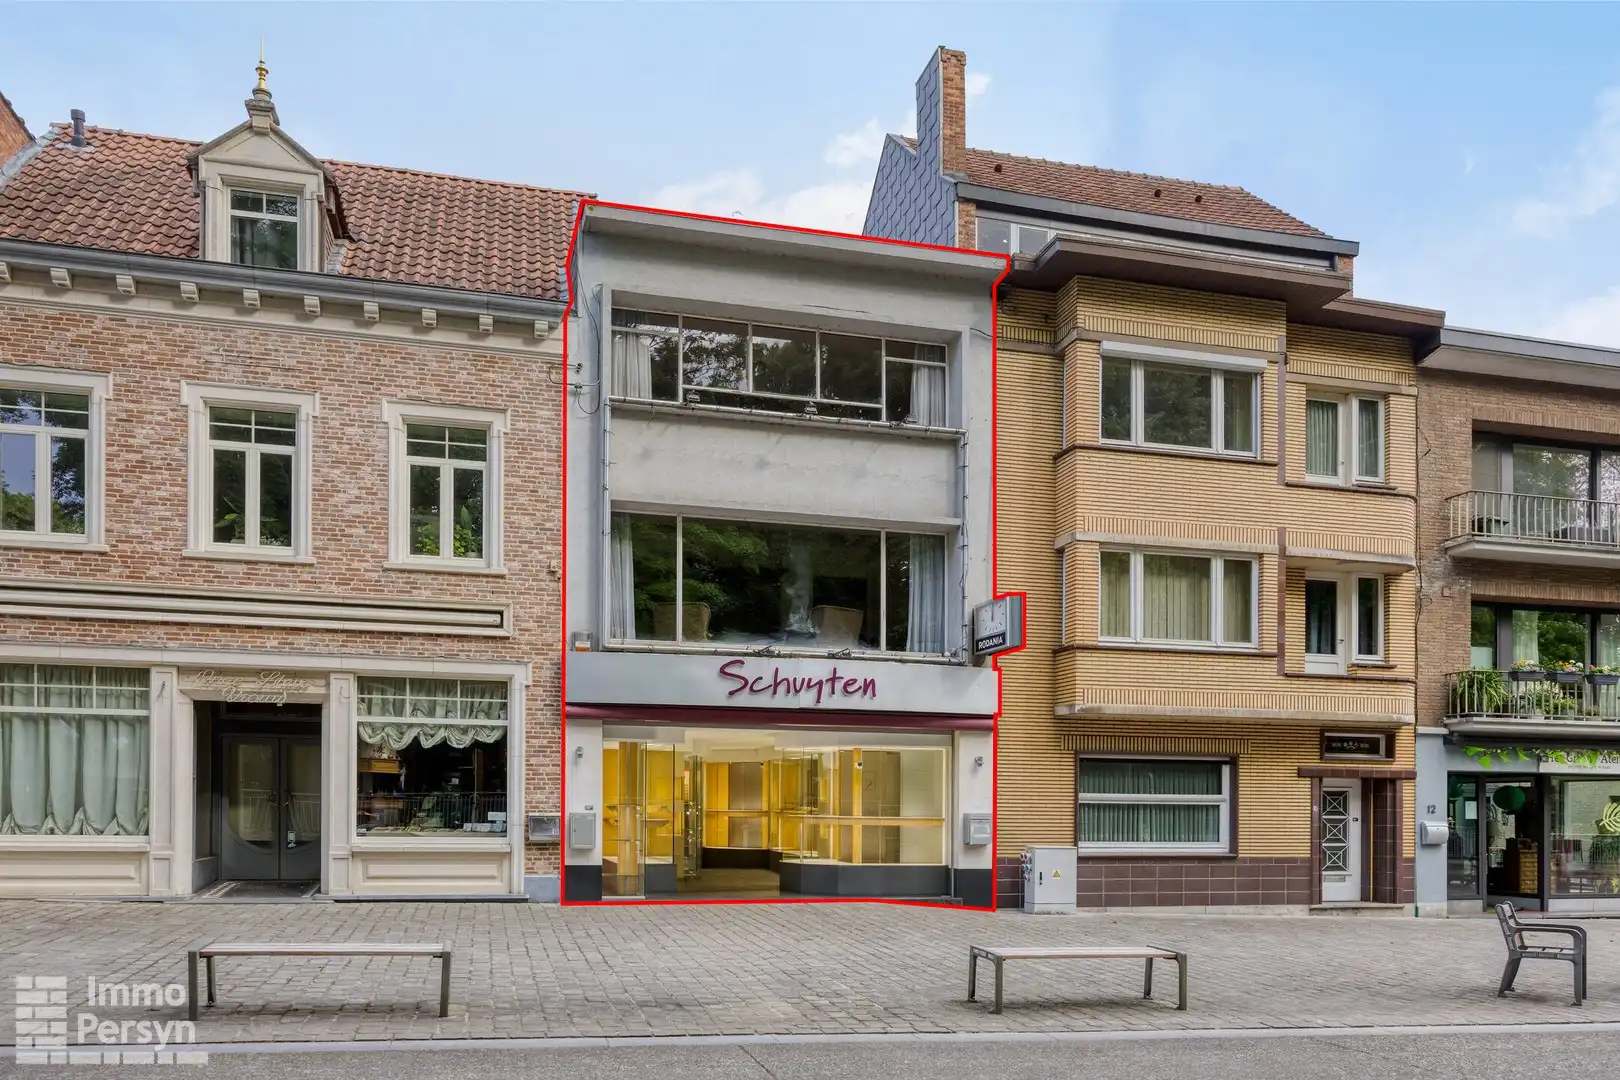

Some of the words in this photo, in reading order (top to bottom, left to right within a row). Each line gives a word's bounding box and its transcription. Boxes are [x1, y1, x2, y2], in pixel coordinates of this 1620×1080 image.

[978, 636, 1004, 650] RODANIA
[719, 659, 876, 704] Schuyten
[1427, 805, 1436, 815] 12
